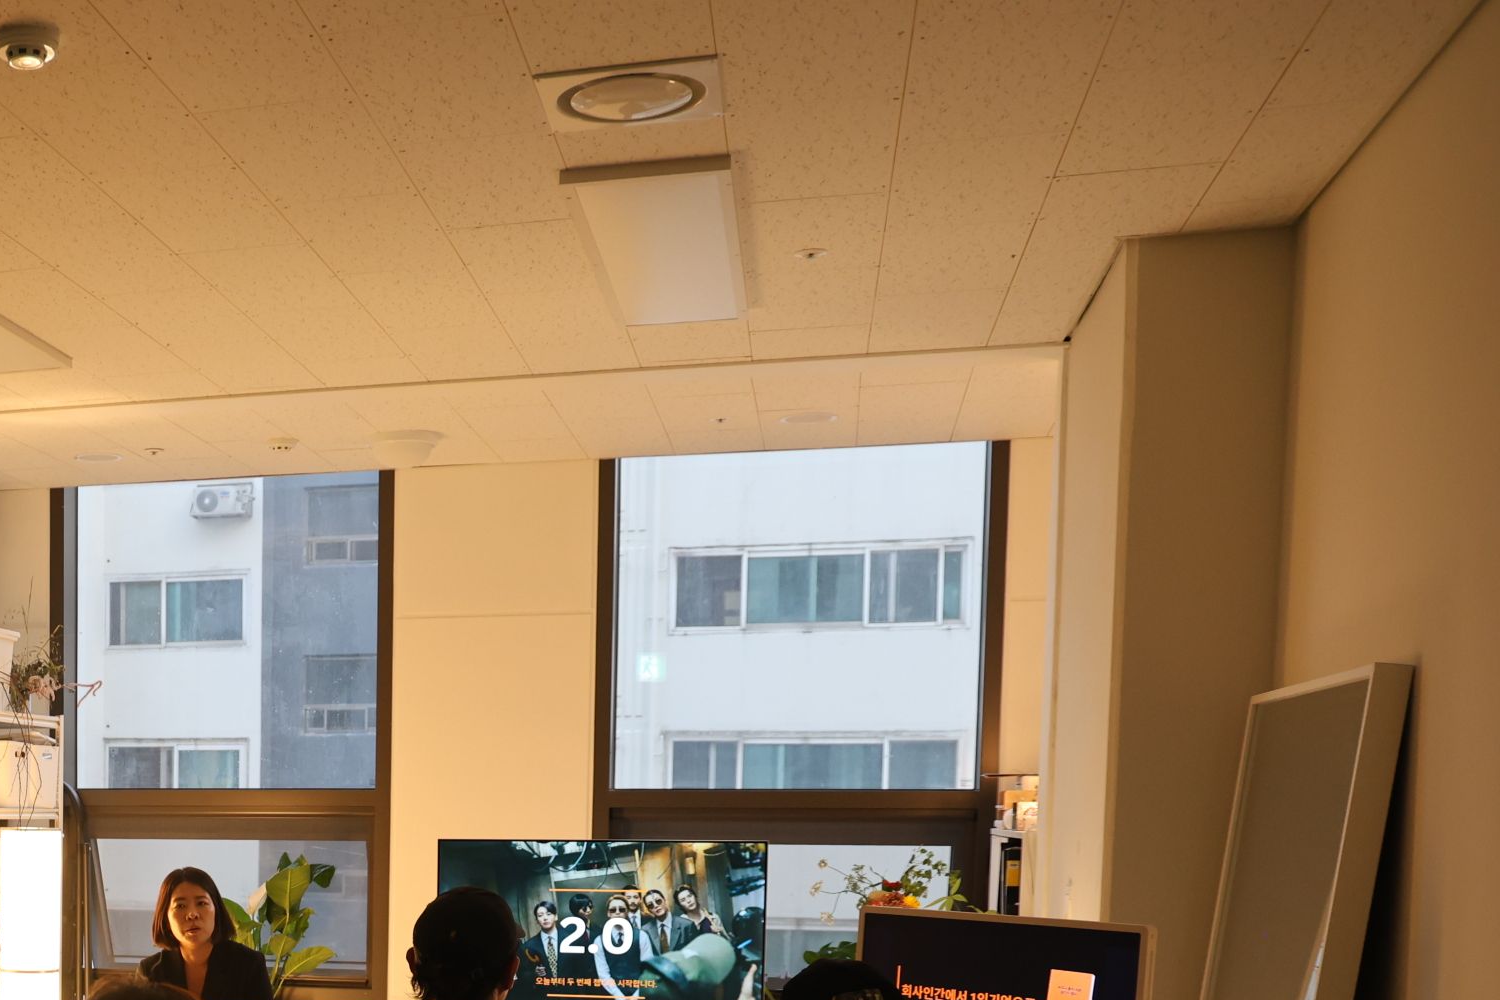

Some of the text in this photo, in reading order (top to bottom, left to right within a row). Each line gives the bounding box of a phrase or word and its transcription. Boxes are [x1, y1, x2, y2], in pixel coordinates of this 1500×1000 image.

[559, 916, 633, 956] 2.0
[535, 977, 566, 986] 오늘부터
[567, 978, 575, 986] 두
[577, 978, 591, 987] 번째
[618, 979, 658, 988] 시작합니다.
